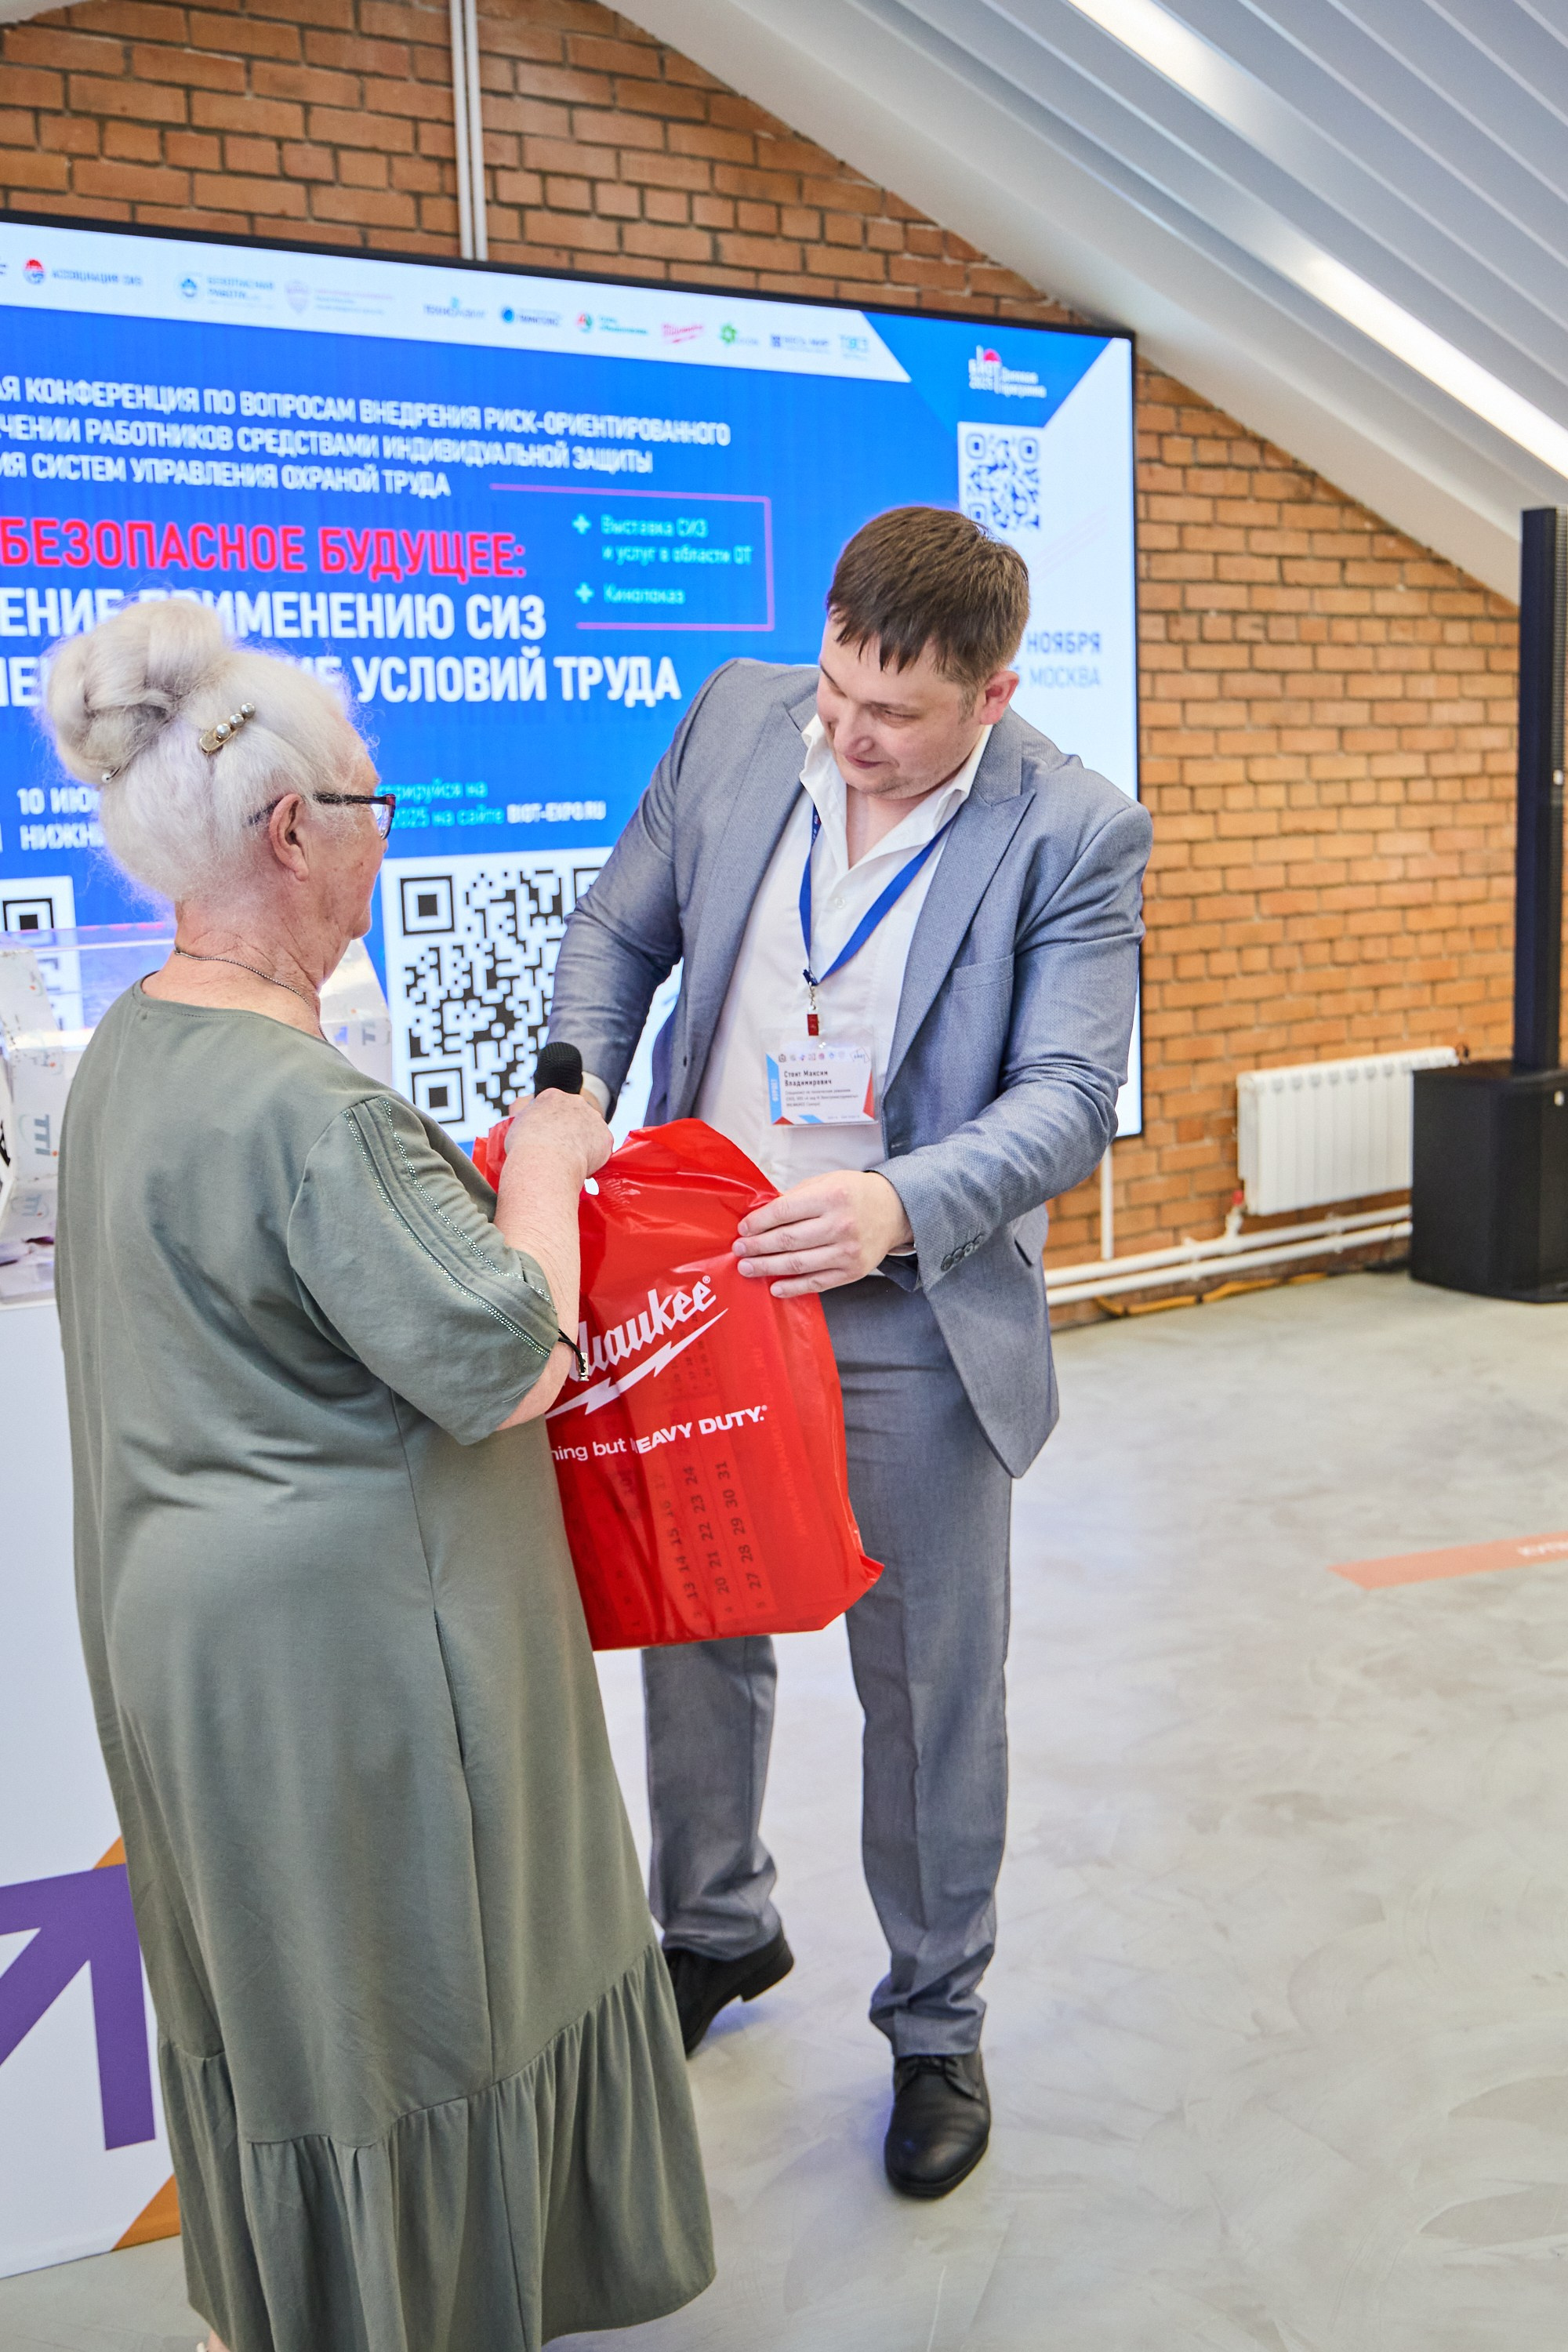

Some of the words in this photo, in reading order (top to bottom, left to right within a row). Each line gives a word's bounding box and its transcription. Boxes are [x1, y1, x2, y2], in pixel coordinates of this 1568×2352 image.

[25, 377, 199, 414] КОНФЕРЕНЦИЯ
[203, 389, 236, 415] ПО
[240, 390, 356, 422] ВОПРОСАМ
[359, 399, 481, 430] ВНЕДРЕНИЯ
[484, 407, 731, 446] РИСК-ОРИЕНТИРОВАННОГО
[85, 418, 234, 451] РАБОТНИКОВ
[237, 426, 379, 459] СРЕДСТВАМИ
[383, 434, 570, 469] ИНДИВИДУАЛЬНОЙ
[573, 446, 653, 474] ЗАЩИТЫ
[31, 452, 126, 482] СИСТЕМ
[129, 457, 278, 489] УПРАВЛЕНИЯ
[281, 463, 380, 493] ОХРАНОЙ
[382, 469, 452, 499] ТРУДА
[0, 517, 307, 572] БЕЗОПАСНОЕ
[318, 528, 525, 584] БУДУЩЕЕ:
[139, 588, 455, 640] ИМЕНЕНИЮ
[466, 593, 546, 640] СИЗ
[1027, 632, 1101, 653] НОЯБРЯ
[352, 645, 547, 702] УСЛОВИЙ
[554, 656, 681, 707] ТРУДА
[1029, 666, 1100, 688] МОСКВА
[16, 787, 45, 815] 10
[593, 1438, 626, 1457] but
[630, 1421, 692, 1454] EAVY
[684, 1466, 698, 1486] 24
[715, 1461, 731, 1480] 31
[691, 1494, 706, 1514] 23
[723, 1490, 739, 1509] 30
[699, 1522, 714, 1541] 22
[731, 1517, 746, 1536] 29
[676, 1555, 690, 1572] 14
[707, 1551, 722, 1568] 21
[739, 1544, 753, 1563] 28
[684, 1582, 699, 1600] 13
[715, 1577, 730, 1594] 20
[746, 1572, 762, 1590] 27
